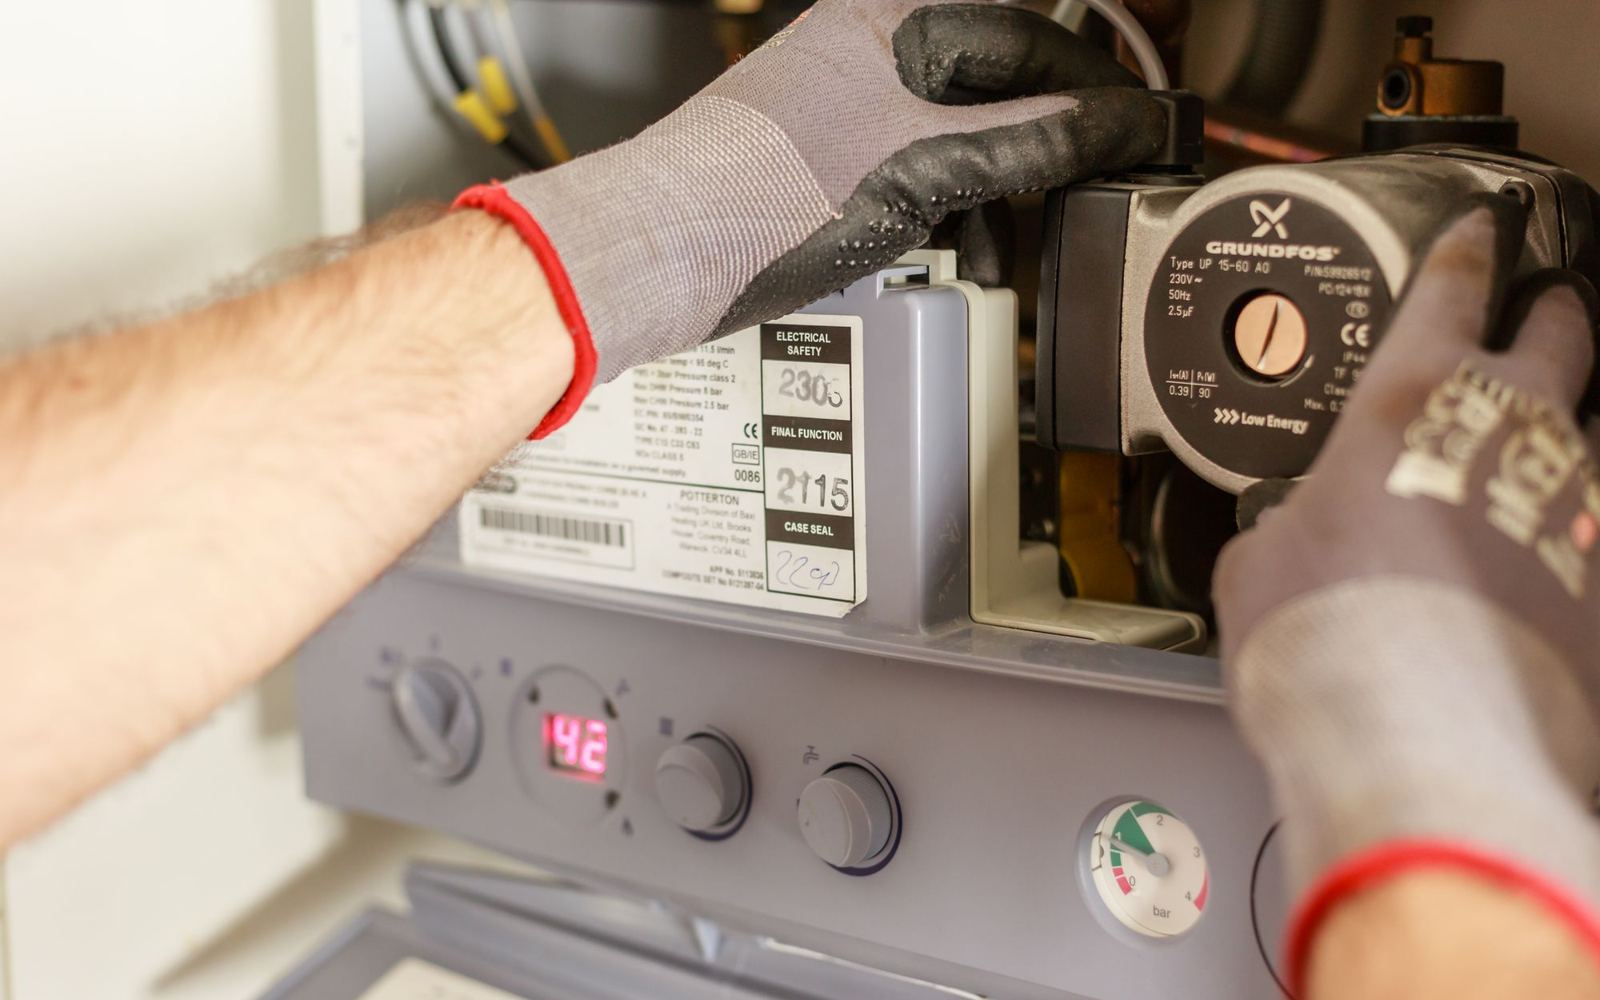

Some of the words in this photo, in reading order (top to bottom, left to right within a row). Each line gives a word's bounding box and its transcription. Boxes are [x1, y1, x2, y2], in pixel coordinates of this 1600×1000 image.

[1206, 241, 1336, 261] GRUNDFOS
[1170, 256, 1194, 271] Type
[1199, 258, 1212, 270] UP
[1218, 259, 1250, 273] 15-60
[1168, 289, 1191, 301] 50Hz
[776, 331, 831, 343] ELECTRICAL
[1341, 322, 1370, 348] CE
[787, 345, 822, 356] SAFETY
[1169, 385, 1189, 396] 0.39
[1198, 388, 1210, 398] 90
[744, 422, 758, 439] CE
[1241, 412, 1265, 426] Low
[1266, 414, 1309, 435] Energy
[771, 426, 796, 438] FINAL
[798, 428, 843, 441] FUNCTION
[734, 469, 760, 483] 0086
[777, 466, 849, 512] 2115
[680, 489, 740, 506] POTTERTON
[784, 521, 809, 533] CASE
[810, 524, 834, 536] SEAL
[553, 713, 608, 774] 42
[1156, 814, 1164, 826] 2
[1193, 846, 1201, 858] 3
[1129, 875, 1136, 887] 0
[1185, 890, 1192, 901] 4
[1153, 905, 1171, 918] bar
